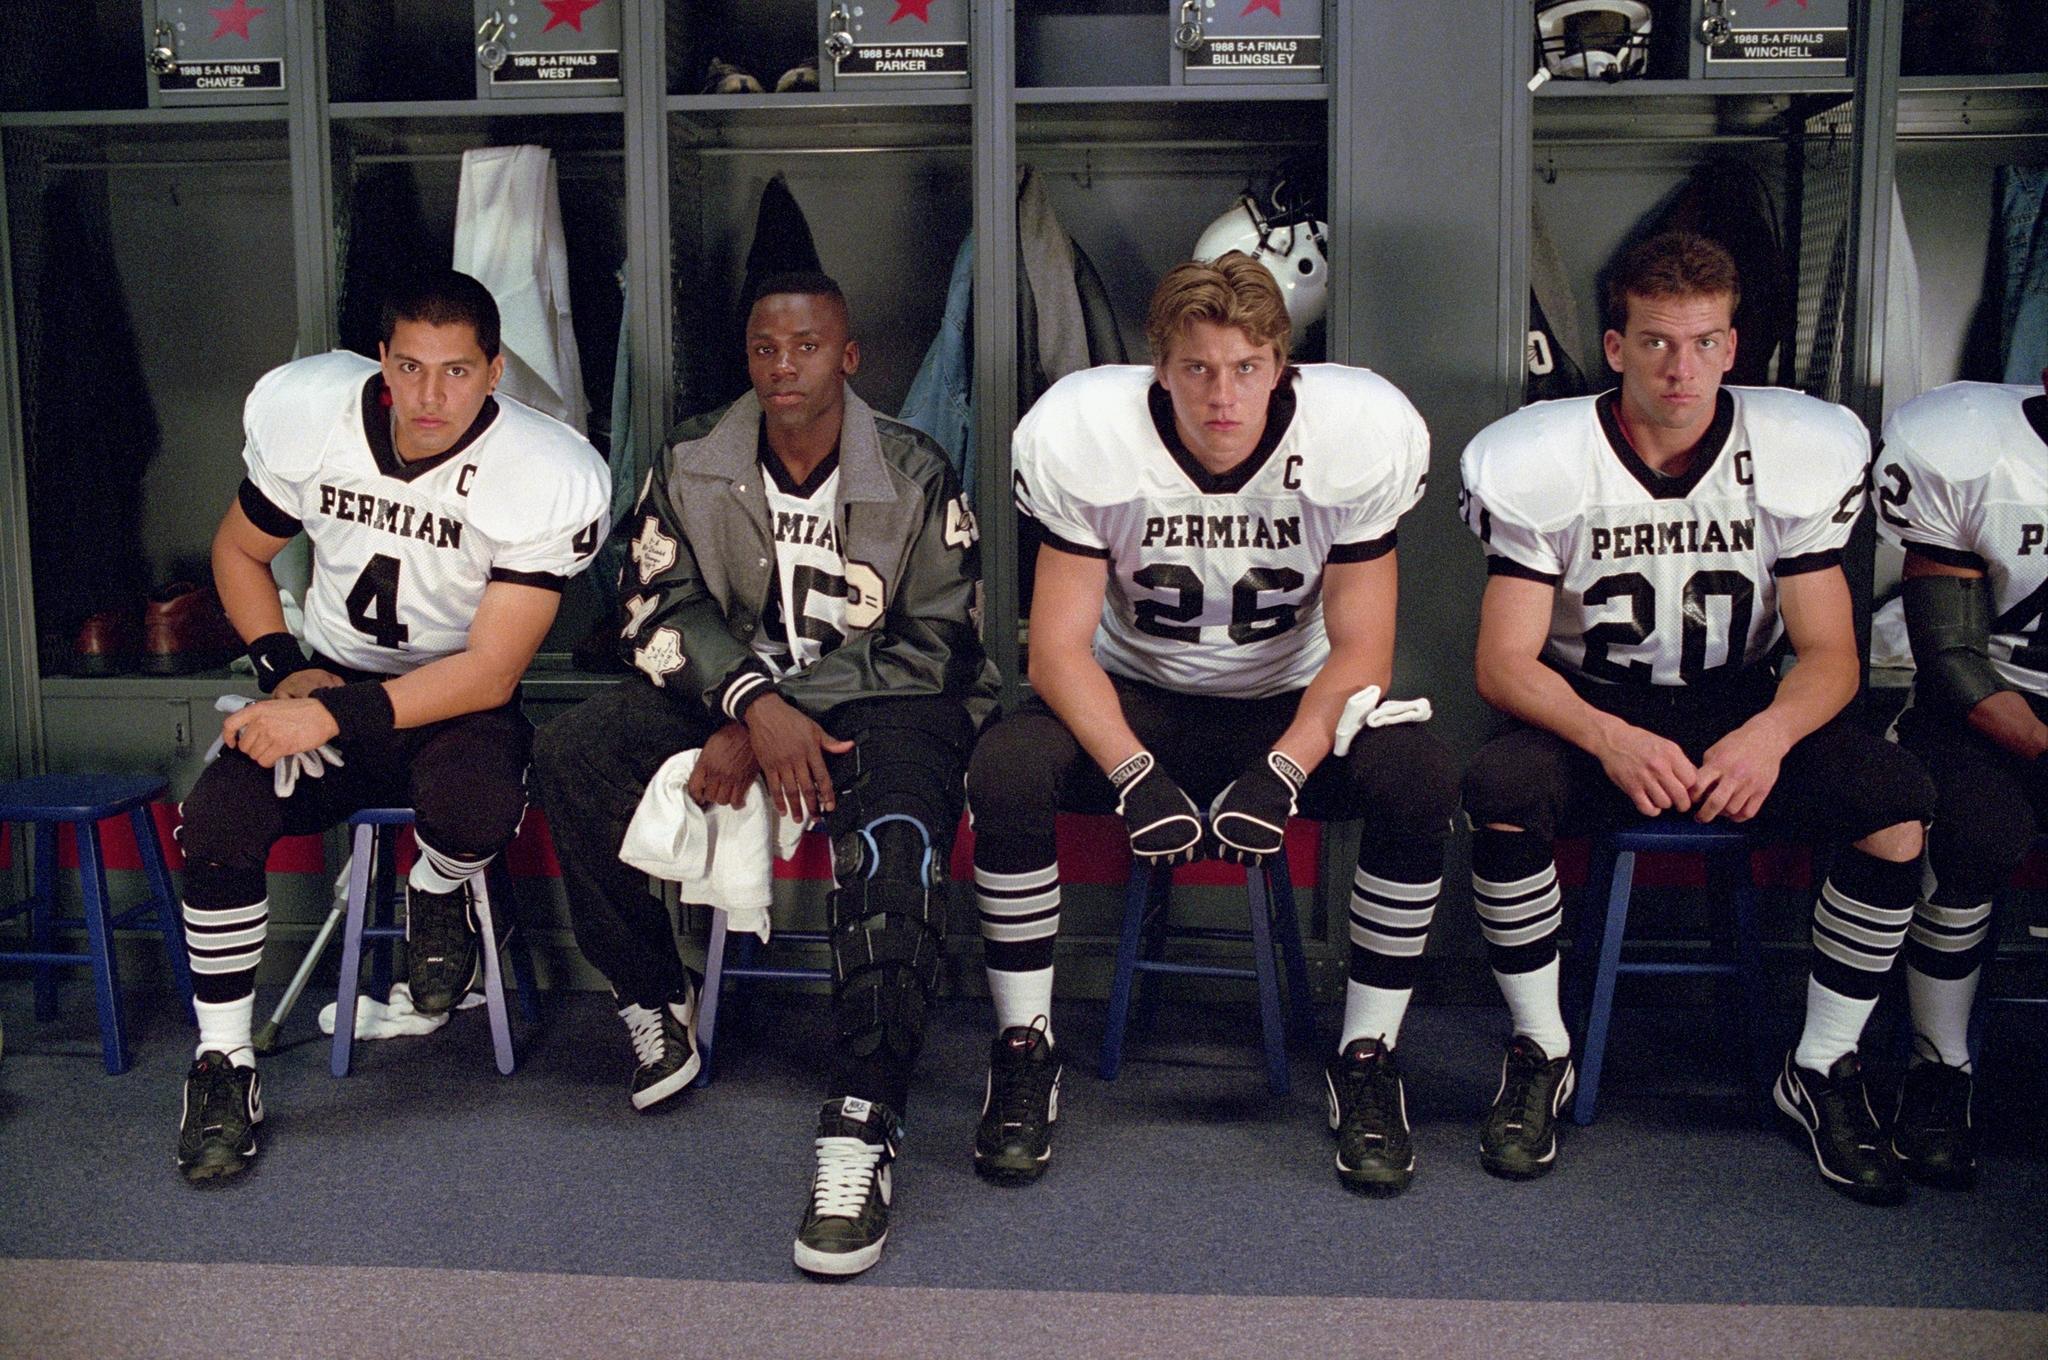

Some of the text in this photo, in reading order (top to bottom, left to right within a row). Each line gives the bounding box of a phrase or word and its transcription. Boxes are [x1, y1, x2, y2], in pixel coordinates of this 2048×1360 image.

[858, 48, 945, 59] 1988 5-A FINALS
[1210, 41, 1298, 52] 1988 5-A FINALS
[1733, 33, 1824, 44] 1988 5-A FINALS
[1744, 46, 1812, 58] WINCHELL
[180, 65, 261, 76] 1988 5-A FINALS
[514, 56, 597, 67] 1988 5-A FINALS
[537, 67, 574, 78] WEST
[875, 60, 926, 71] PARKER
[1213, 54, 1295, 64] BILLINGSLEY
[196, 77, 244, 88] CHAVEZ
[456, 464, 477, 497] C
[1283, 455, 1303, 489] C
[1734, 450, 1754, 485] C
[320, 484, 463, 549] PERMIAN
[1141, 514, 1302, 550] PERMIAN
[1591, 519, 1755, 560] PERMIAN
[2017, 523, 2048, 556] P
[345, 553, 409, 651] 4
[792, 564, 849, 668] 5
[1133, 563, 1304, 645] 26
[1581, 570, 1754, 686] 20
[1111, 756, 1148, 788] CUTTERS
